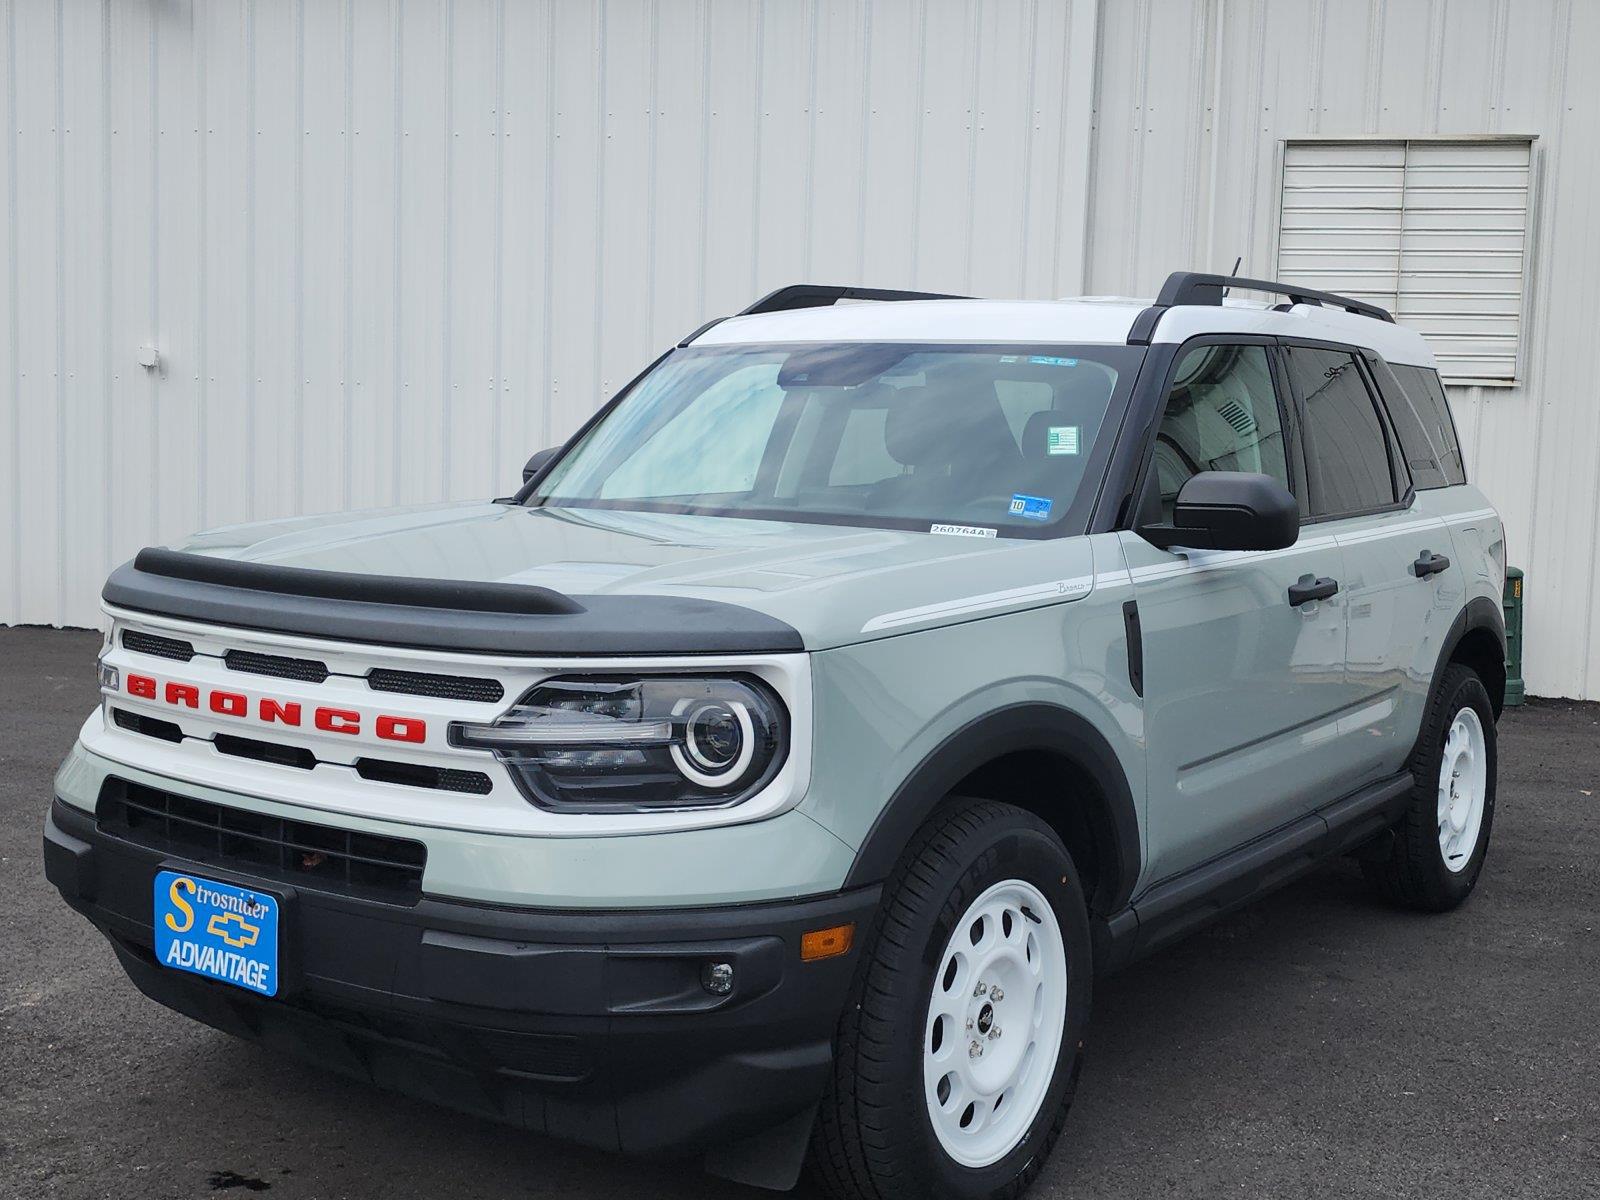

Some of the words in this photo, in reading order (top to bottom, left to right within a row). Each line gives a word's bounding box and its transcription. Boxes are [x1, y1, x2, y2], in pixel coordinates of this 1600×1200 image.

[1013, 501, 1023, 510] 10
[127, 673, 427, 744] BRONCO
[165, 877, 269, 932] Strosnider
[166, 939, 270, 991] ADVANTAGE
